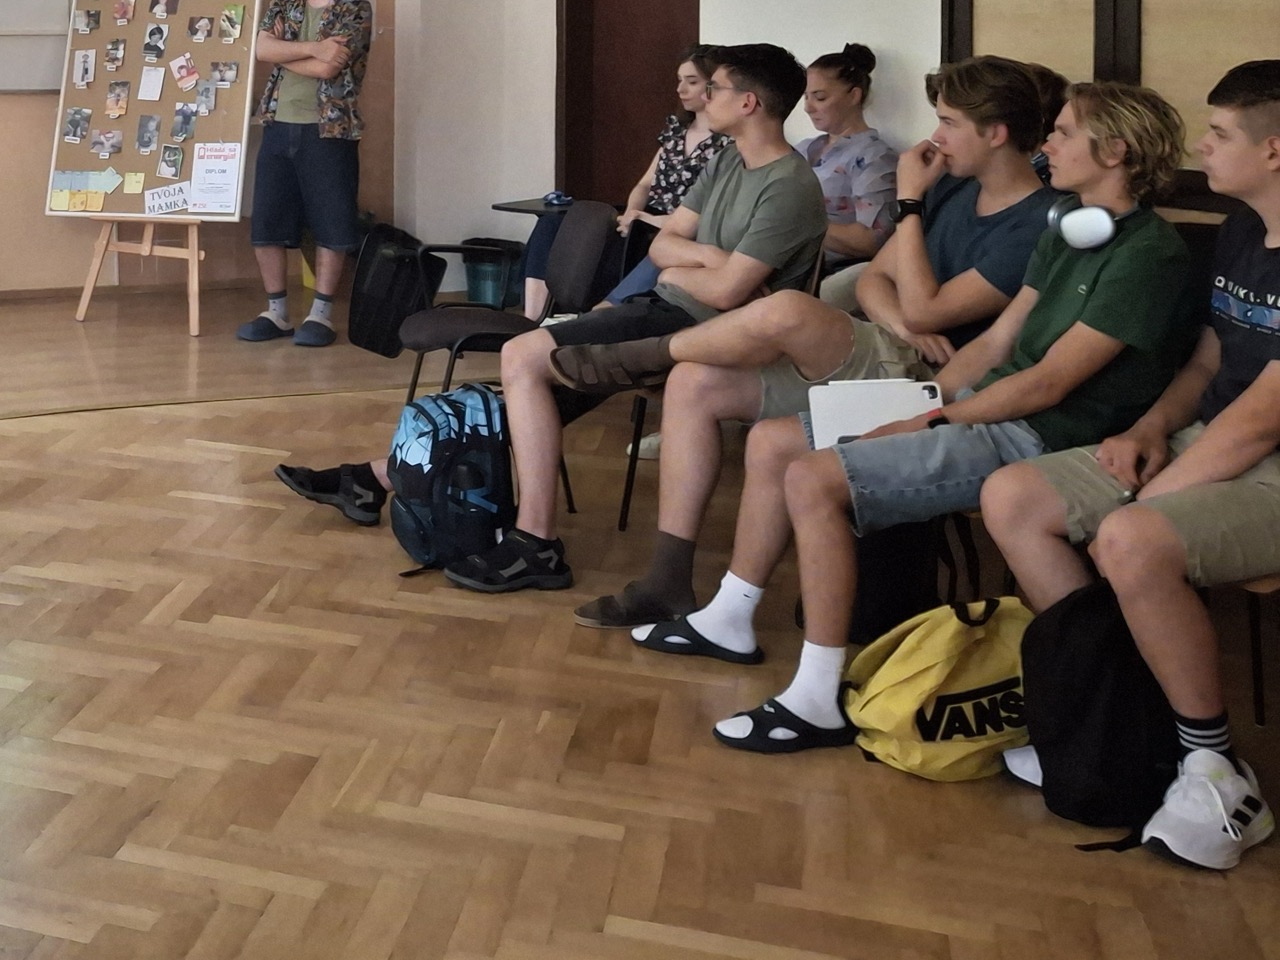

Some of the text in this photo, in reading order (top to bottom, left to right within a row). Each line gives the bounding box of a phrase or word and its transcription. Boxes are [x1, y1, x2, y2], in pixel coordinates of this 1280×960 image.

[150, 187, 184, 201] TVOJA
[148, 198, 189, 214] MAMKA
[916, 676, 1027, 742] VANS
